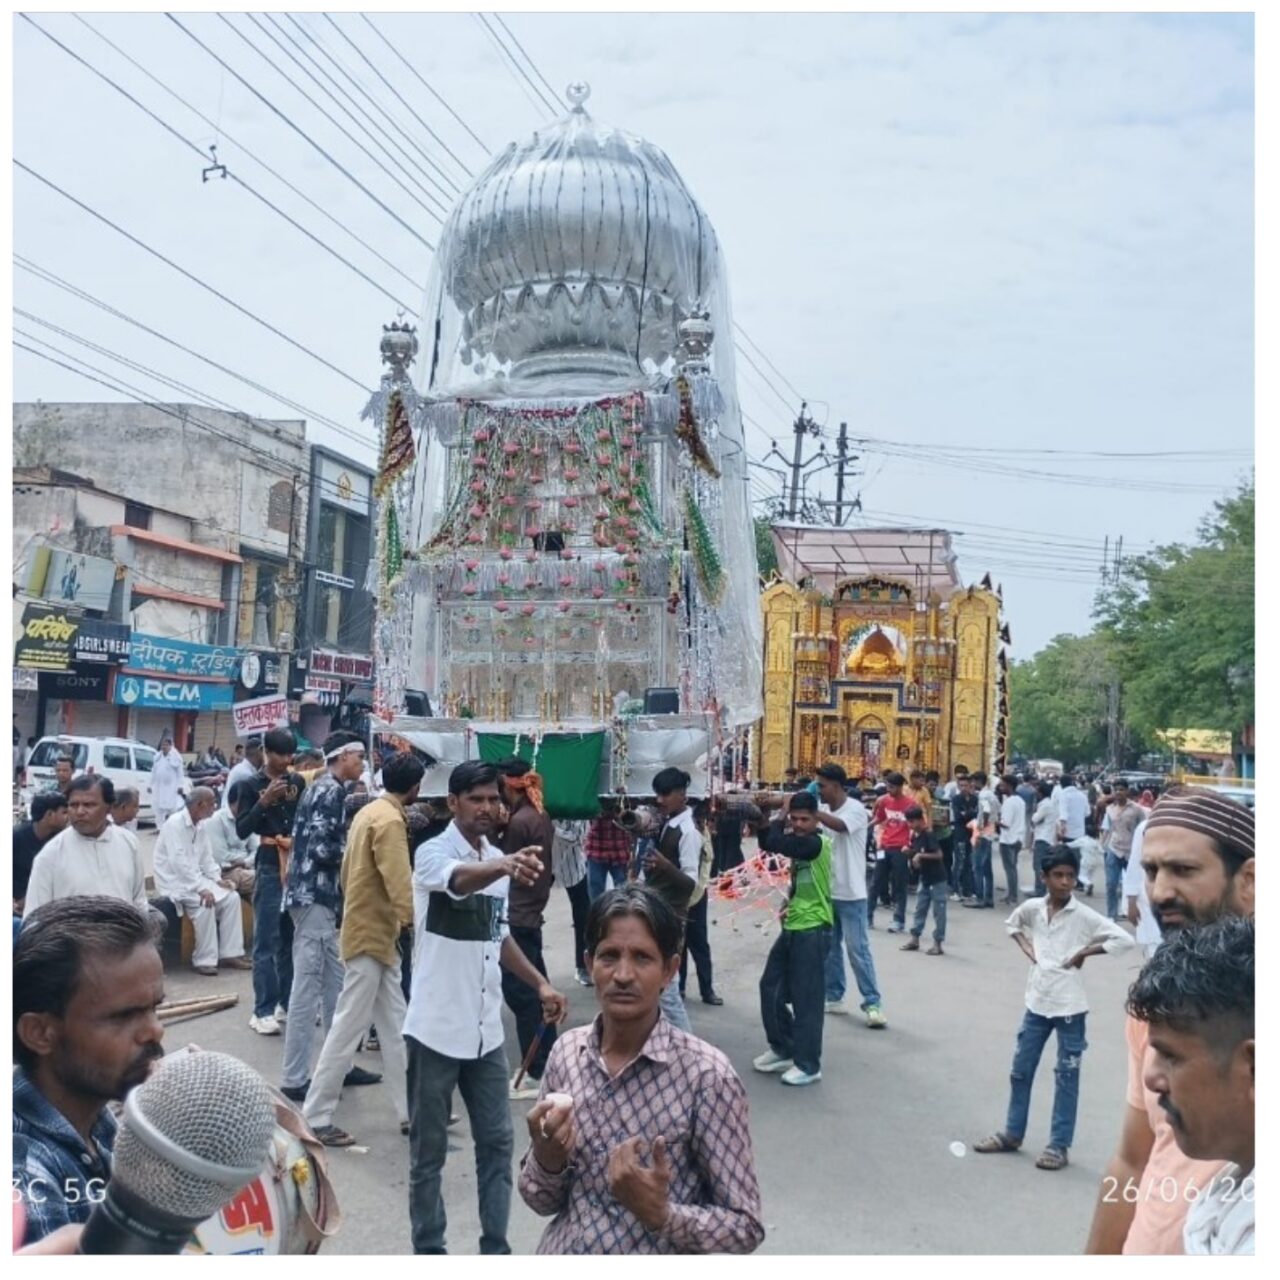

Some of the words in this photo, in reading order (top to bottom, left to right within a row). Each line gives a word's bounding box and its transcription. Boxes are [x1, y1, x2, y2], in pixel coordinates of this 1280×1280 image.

[132, 638, 188, 665] दीपक
[56, 676, 101, 687] SONY
[143, 680, 200, 703] RCM
